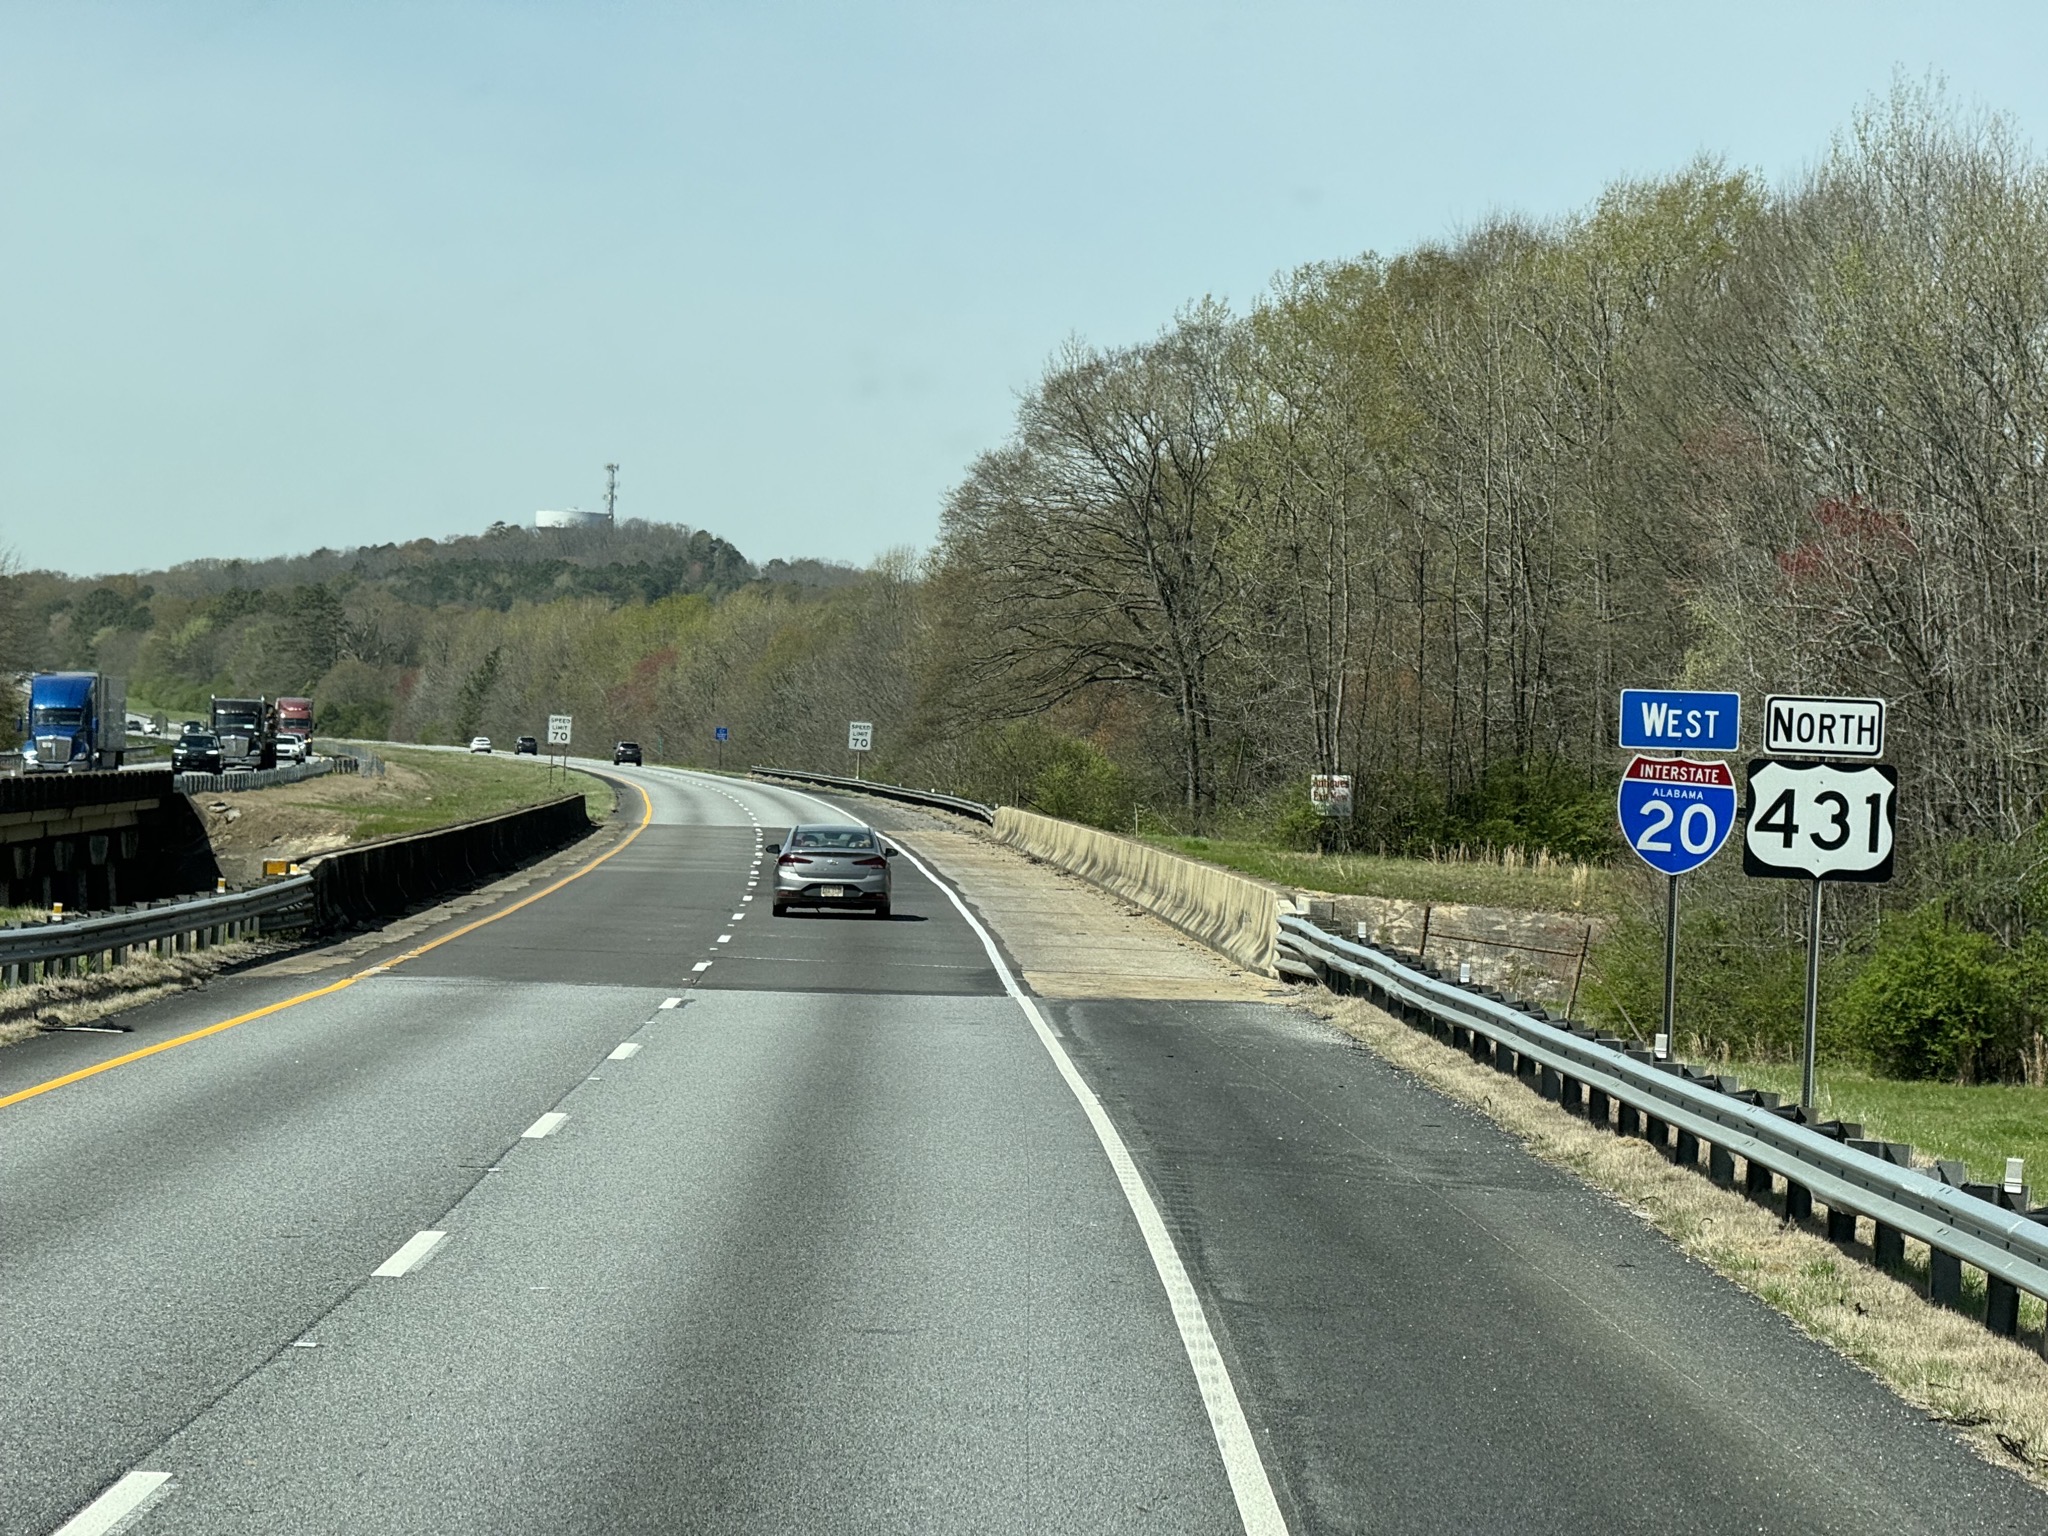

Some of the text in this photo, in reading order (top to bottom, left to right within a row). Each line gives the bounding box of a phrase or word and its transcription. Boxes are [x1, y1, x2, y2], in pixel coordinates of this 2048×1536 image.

[1641, 702, 1720, 739] WEST
[1772, 707, 1876, 746] NORTH
[552, 731, 568, 741] 70
[852, 738, 868, 748] 70
[1640, 764, 1720, 784] INTERSTATE
[1652, 788, 1704, 800] ALABAMA
[1636, 800, 1717, 855] 20
[1754, 788, 1882, 854] 431
